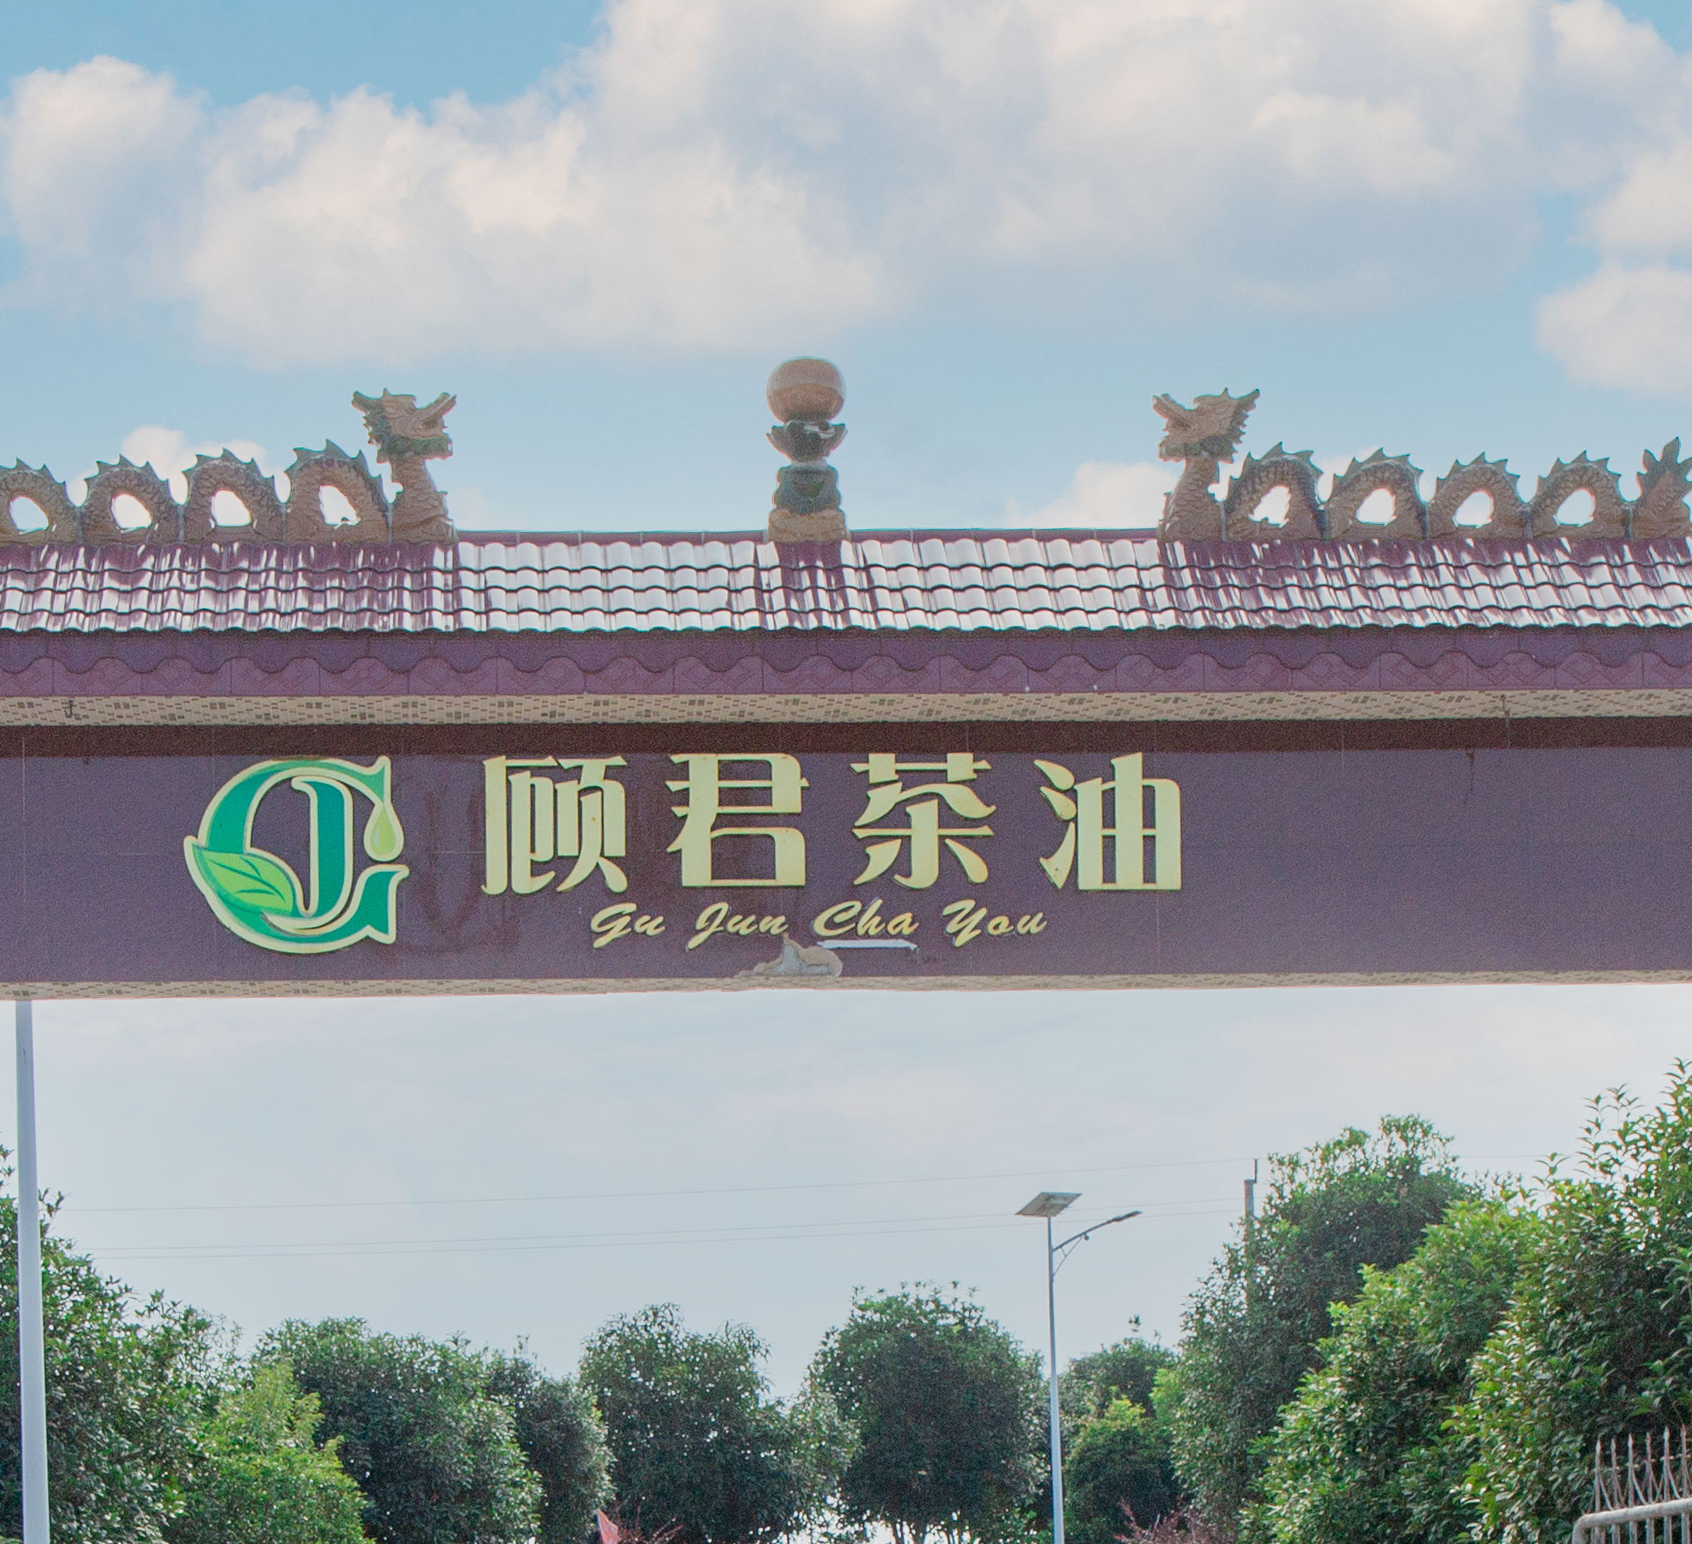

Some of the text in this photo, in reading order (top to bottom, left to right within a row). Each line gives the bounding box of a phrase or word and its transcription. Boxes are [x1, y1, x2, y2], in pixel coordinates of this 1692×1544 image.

[482, 752, 1181, 896] 顾君茶油
[590, 897, 1048, 950] Gu Jun Cha You
